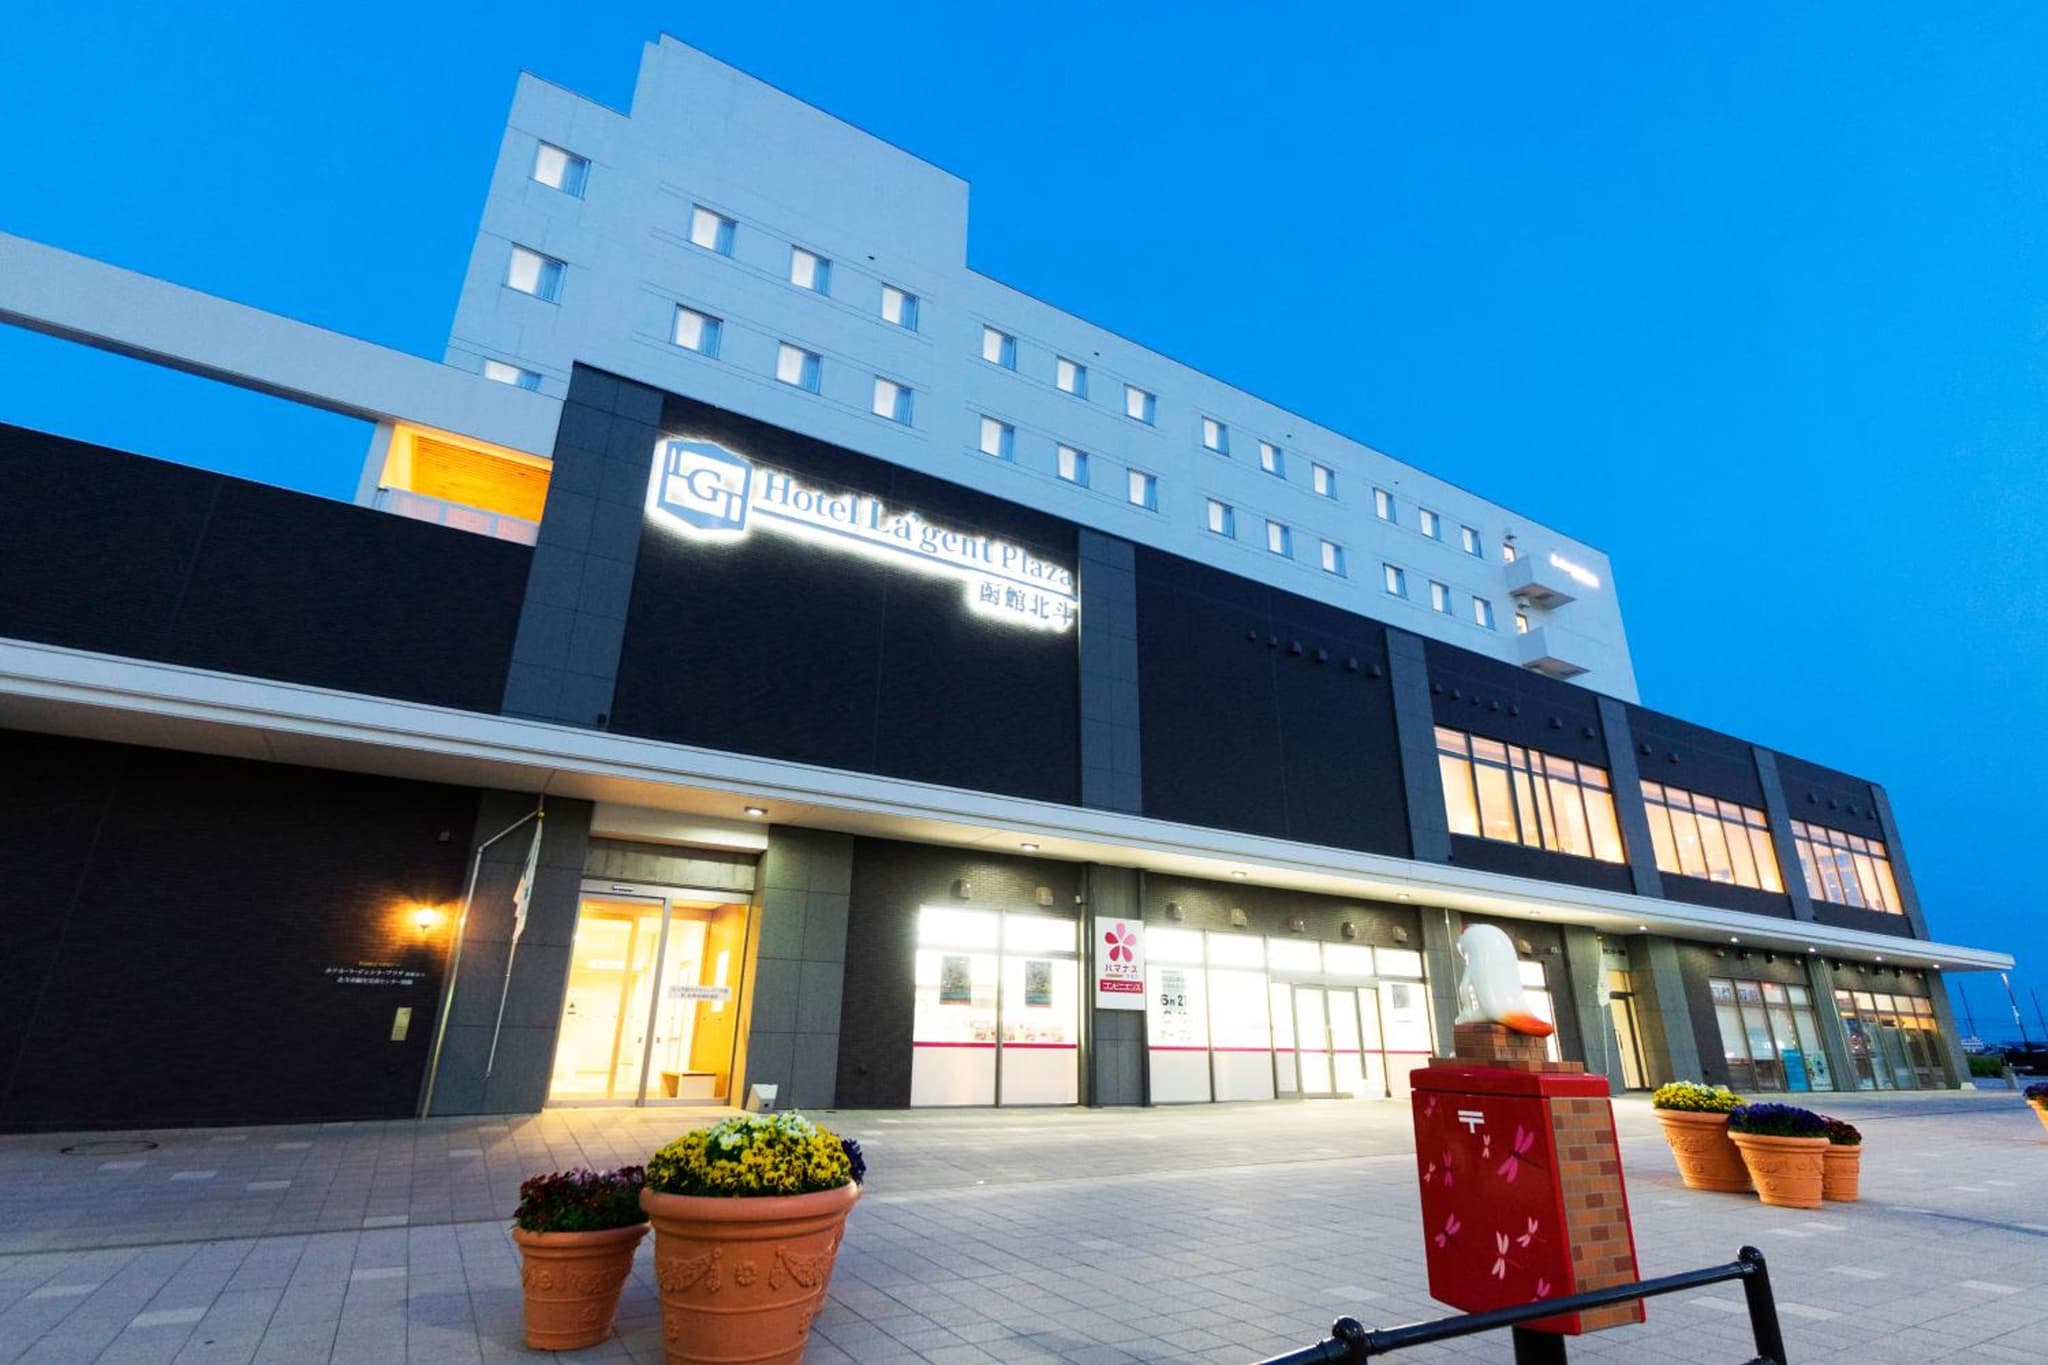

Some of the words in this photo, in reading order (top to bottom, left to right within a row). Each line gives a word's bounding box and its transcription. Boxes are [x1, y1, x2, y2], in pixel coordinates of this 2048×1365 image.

[763, 471, 859, 525] Hotel
[869, 498, 994, 564] La'gent
[1001, 544, 1074, 586] Plaza
[980, 580, 1074, 625] 函館北斗
